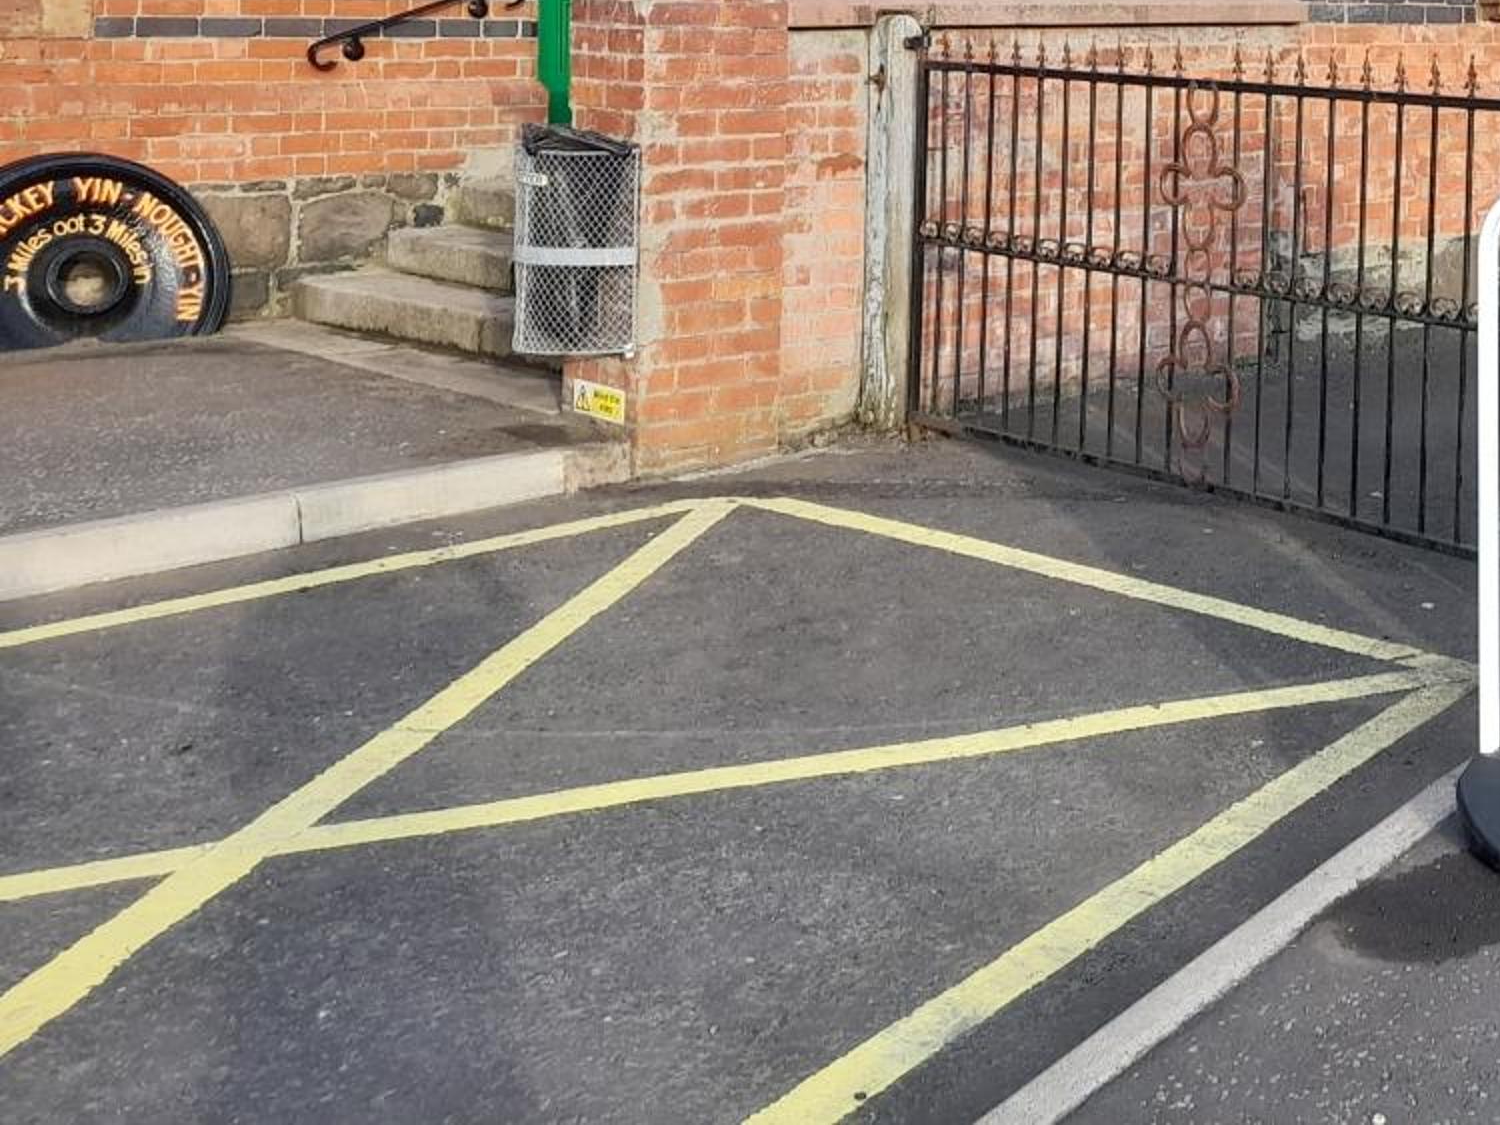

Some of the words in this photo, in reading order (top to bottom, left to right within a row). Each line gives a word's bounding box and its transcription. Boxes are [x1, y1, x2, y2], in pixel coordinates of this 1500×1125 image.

[7, 227, 53, 272] Miles
[53, 213, 86, 236] oot
[89, 213, 107, 236] 3
[105, 220, 148, 265] Miles
